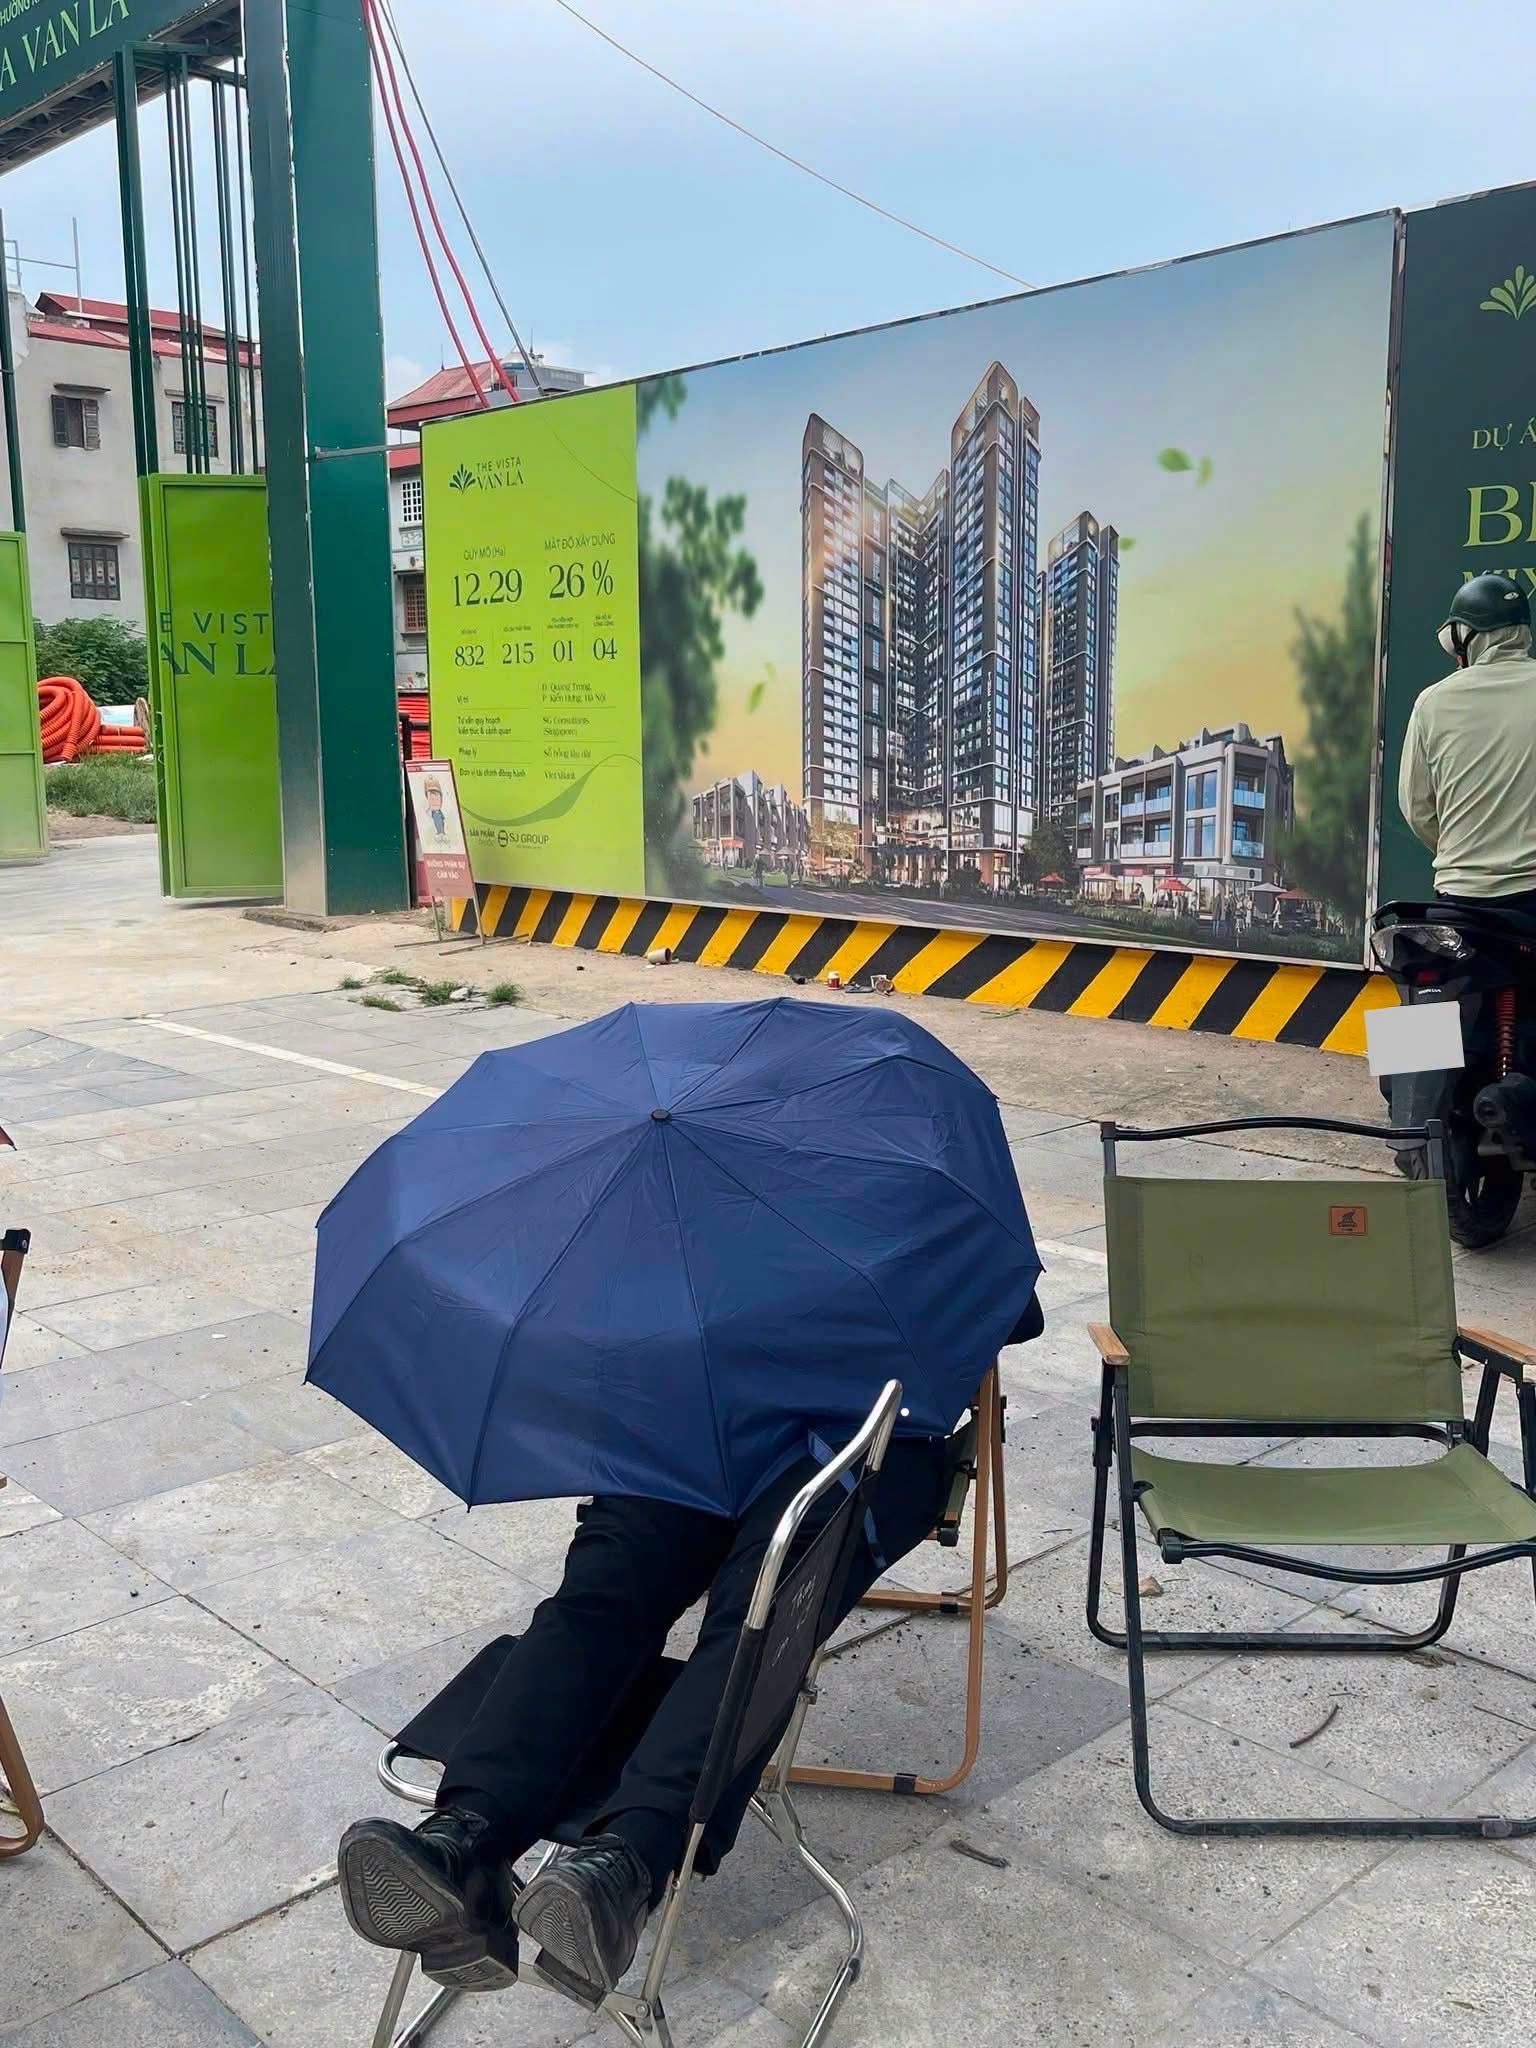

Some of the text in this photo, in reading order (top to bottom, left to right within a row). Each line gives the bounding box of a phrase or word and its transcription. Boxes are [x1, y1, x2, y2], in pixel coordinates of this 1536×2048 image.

[22, 1, 80, 73] VAN
[1473, 423, 1512, 451] DỰ
[477, 456, 521, 472] THE VISTA
[454, 569, 523, 606] 12.29
[549, 559, 614, 599] 26 %
[236, 642, 277, 675] L
[454, 645, 485, 667] 832
[502, 642, 535, 665] 215
[553, 640, 574, 663] 01
[593, 638, 618, 661] 04
